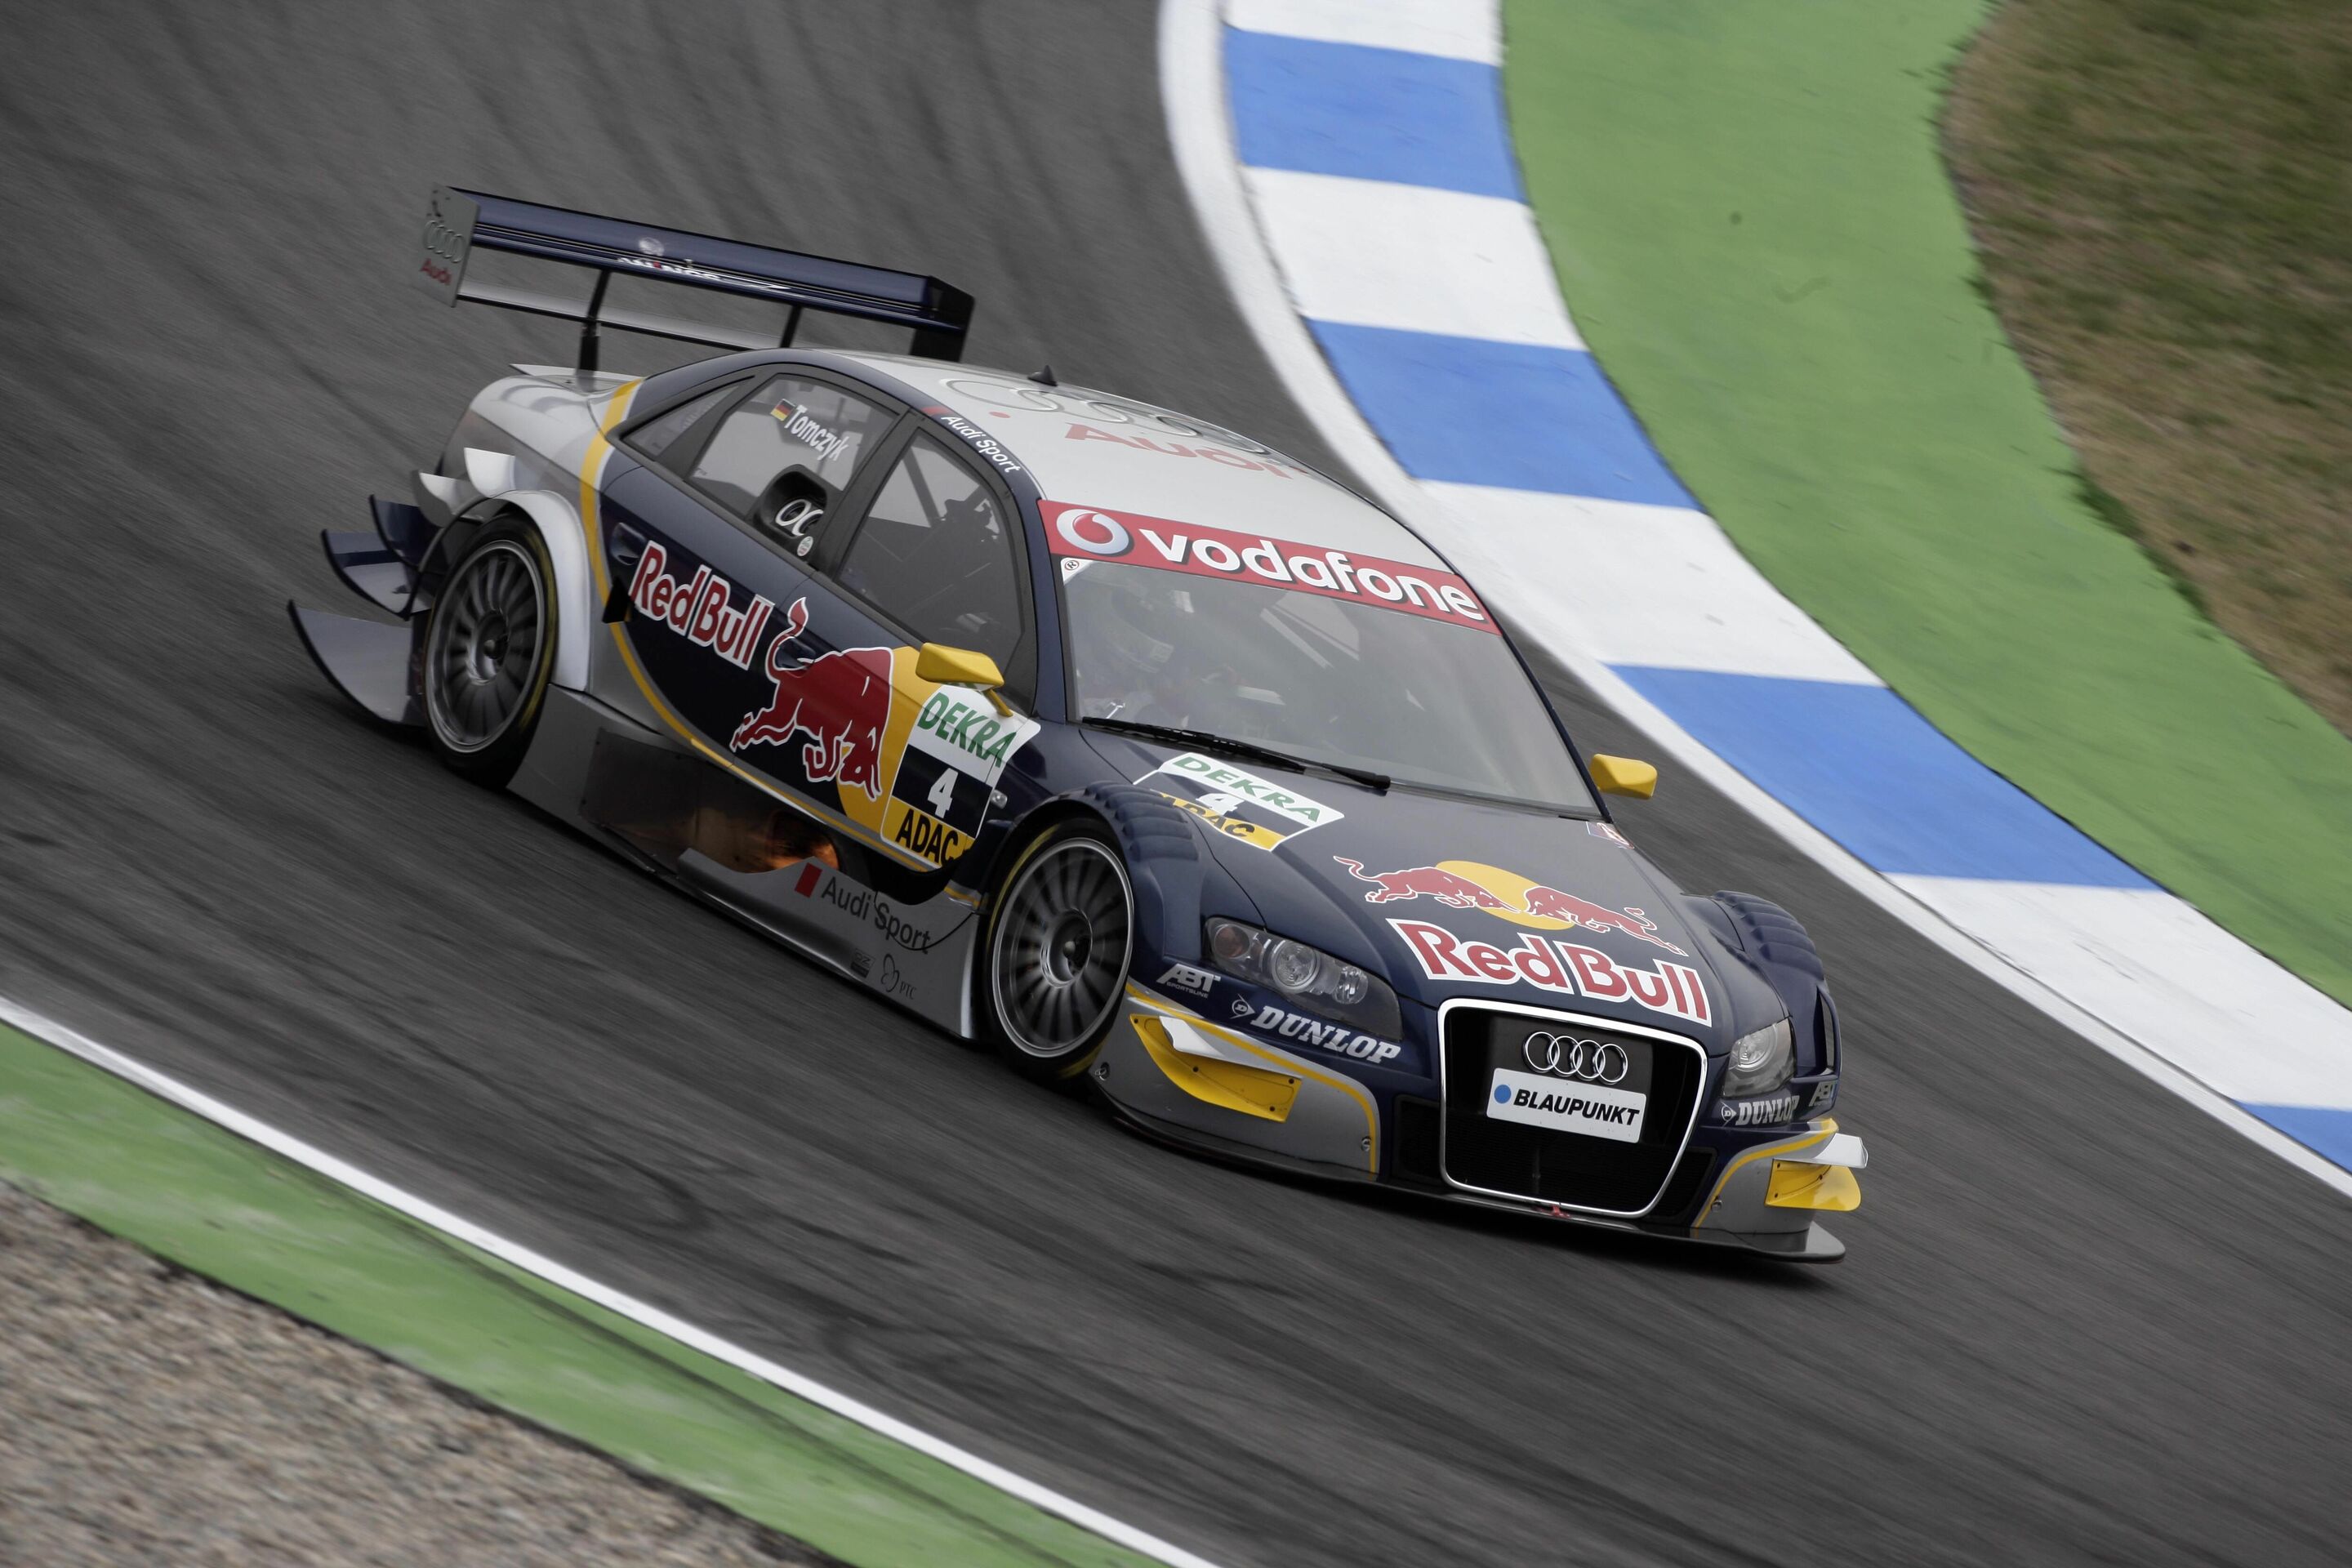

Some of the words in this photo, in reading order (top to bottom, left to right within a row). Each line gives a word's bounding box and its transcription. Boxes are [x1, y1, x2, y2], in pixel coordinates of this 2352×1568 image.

[784, 405, 850, 462] Tomczyk
[941, 415, 981, 442] Audi
[976, 439, 1022, 474] Sport
[1139, 528, 1486, 621] vodafone
[917, 692, 1018, 768] DEKRA
[928, 767, 960, 819] 4
[1172, 756, 1322, 823] DEKRA
[1195, 792, 1245, 817] 4
[895, 808, 960, 869] ADAC
[822, 875, 872, 920] Audi
[875, 902, 931, 955] Sport
[1156, 963, 1222, 992] ABT
[1250, 1005, 1401, 1063] DUNLOP
[1513, 1089, 1640, 1126] BLAUPUNKT
[1735, 1095, 1800, 1126] DUNLOP
